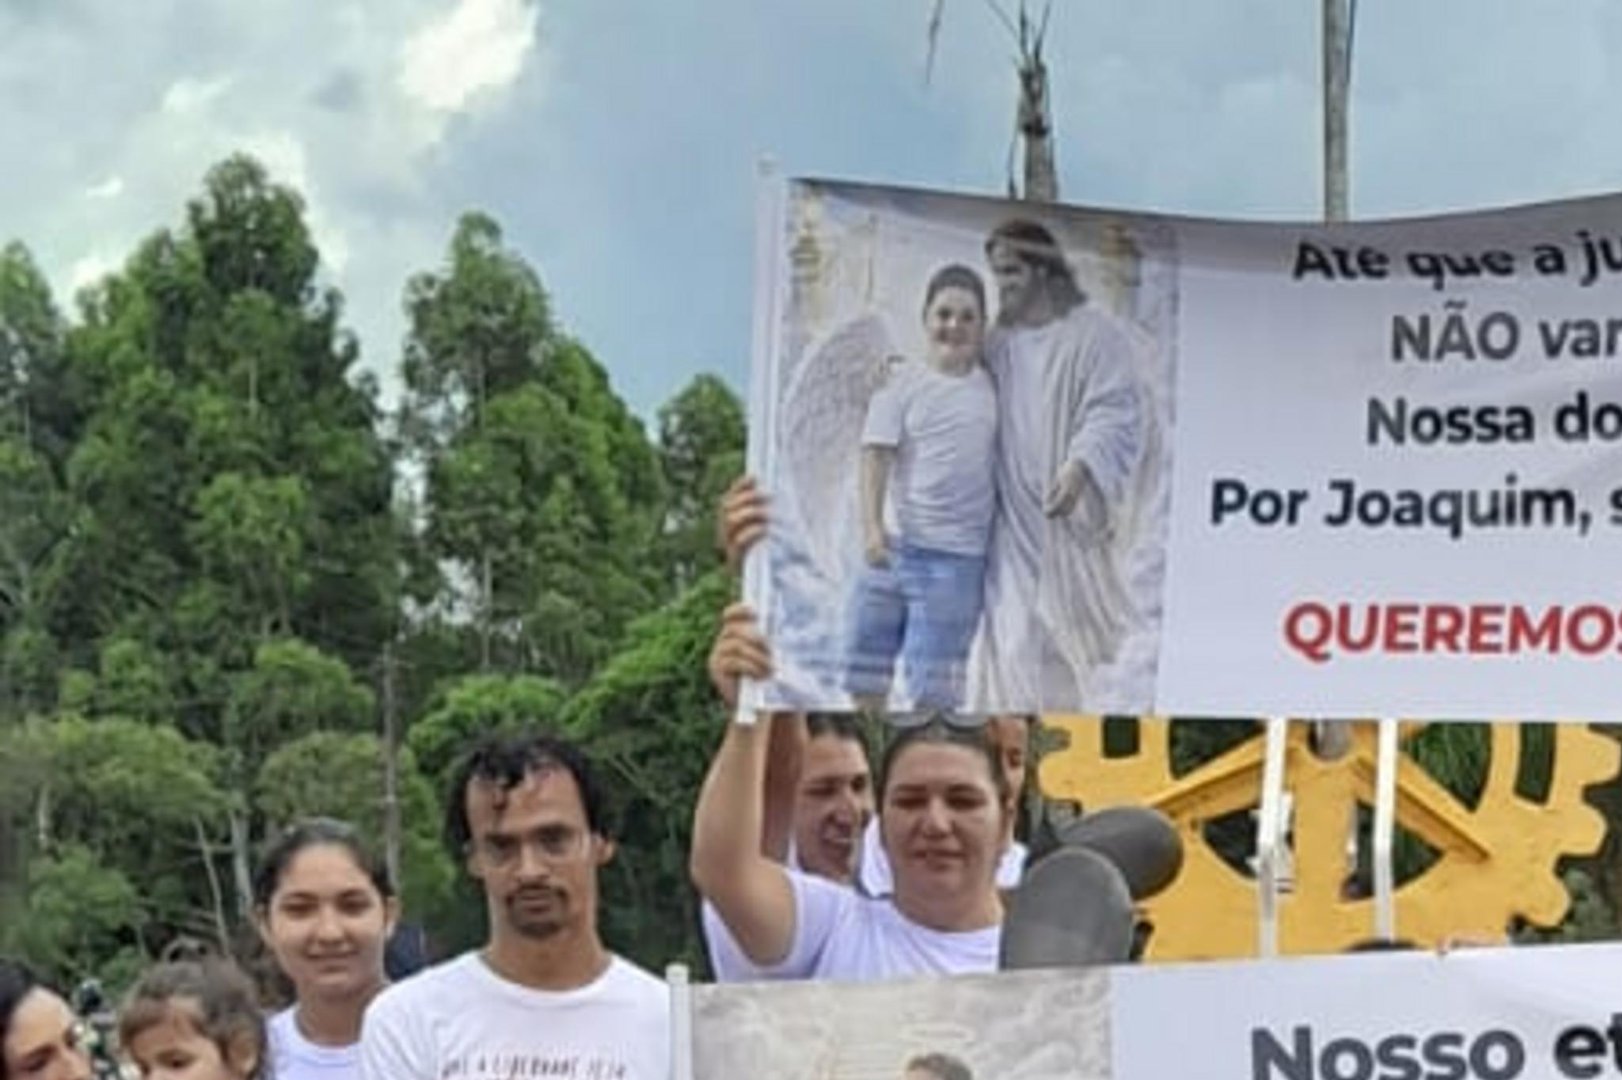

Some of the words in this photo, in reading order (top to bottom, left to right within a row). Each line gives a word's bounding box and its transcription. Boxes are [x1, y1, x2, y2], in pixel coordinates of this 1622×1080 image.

[1405, 249, 1515, 292] que
[1531, 242, 1568, 276] a
[1390, 298, 1522, 364] NÃO
[1366, 395, 1537, 447] Nossa
[1209, 477, 1311, 528] Por
[1322, 471, 1593, 541] Joaquim,
